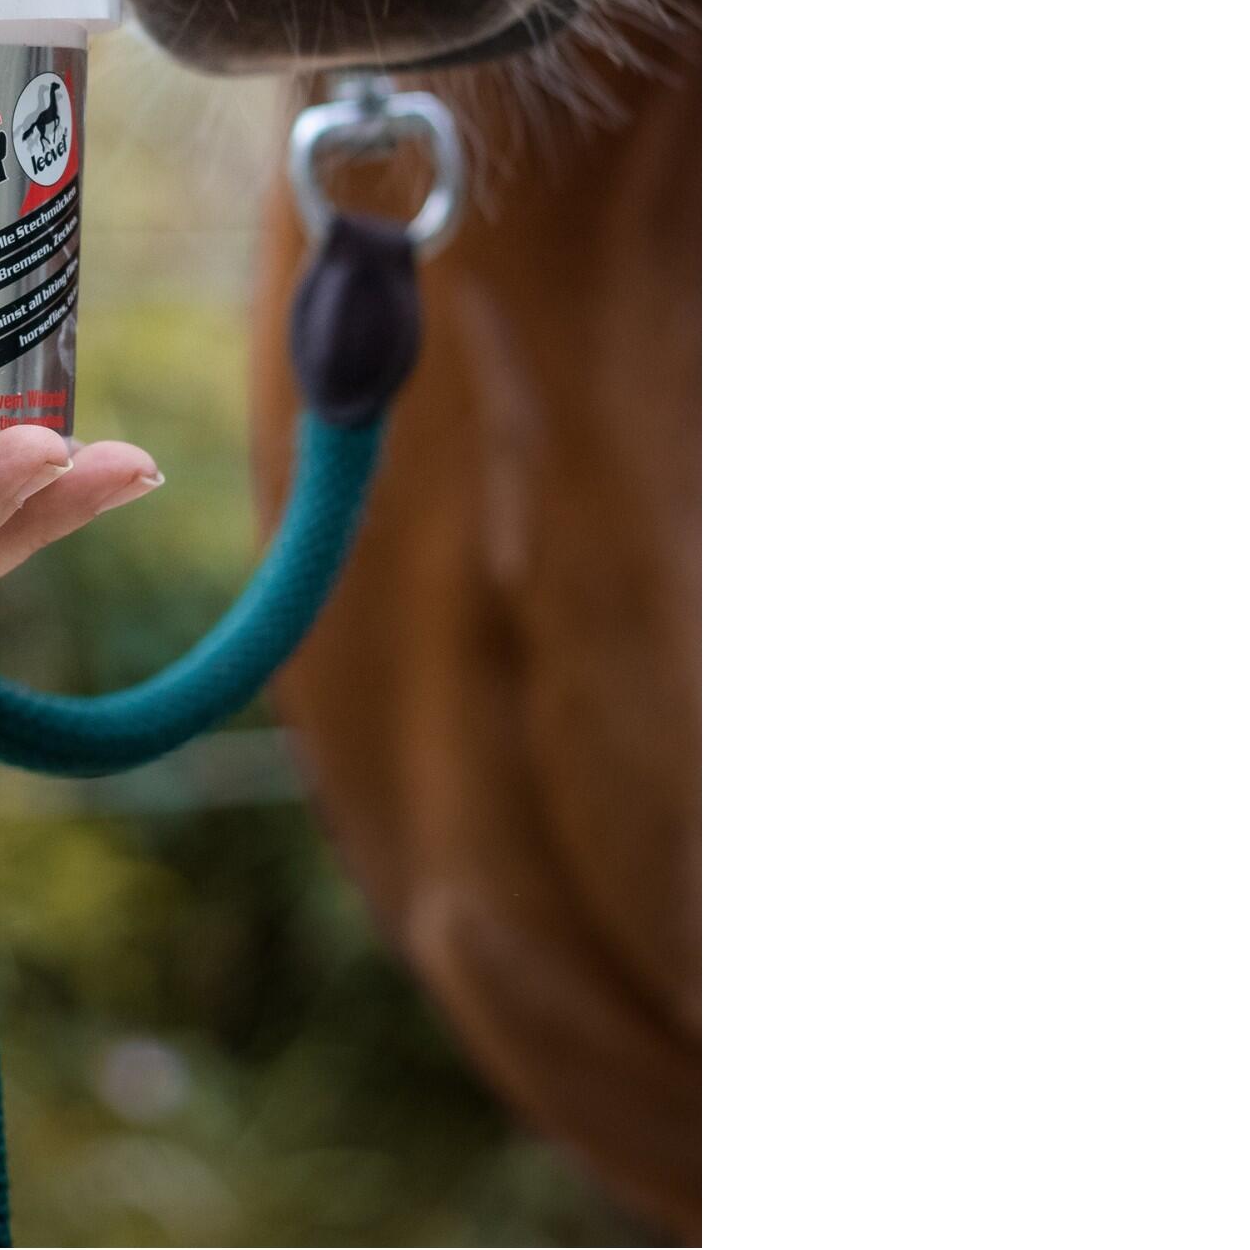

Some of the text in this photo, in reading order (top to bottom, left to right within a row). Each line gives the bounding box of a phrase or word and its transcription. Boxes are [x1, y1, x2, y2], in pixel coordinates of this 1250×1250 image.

[16, 186, 77, 239] Stechmücken
[28, 293, 43, 311] all
[42, 272, 67, 301] biting
